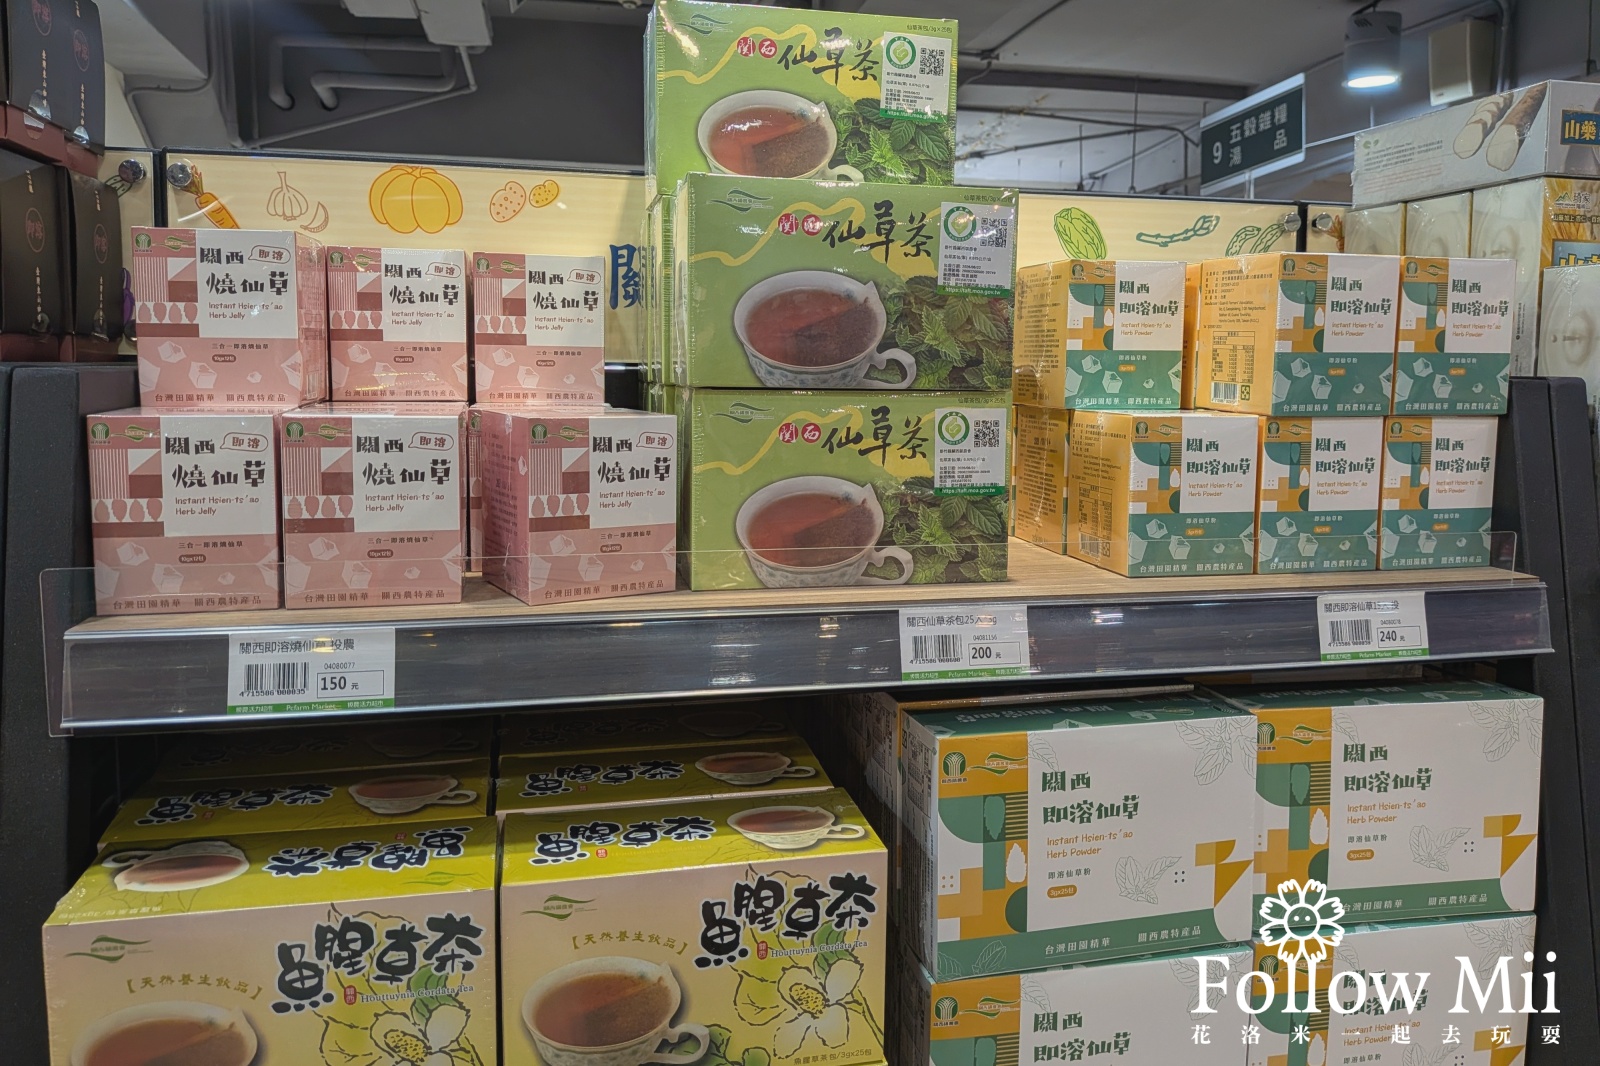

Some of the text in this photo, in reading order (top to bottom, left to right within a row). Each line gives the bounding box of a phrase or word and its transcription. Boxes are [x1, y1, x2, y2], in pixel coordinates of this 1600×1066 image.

[777, 26, 880, 85] 仙草茶
[1564, 119, 1600, 141] 山藥
[1273, 129, 1288, 150] 品
[1212, 142, 1223, 164] 9
[822, 200, 934, 263] 仙草茶
[200, 247, 284, 266] 關西 即溶
[384, 263, 422, 279] 關西
[528, 269, 564, 285] 關西
[205, 270, 288, 297] 燒仙草
[1119, 280, 1150, 294] 關西
[1331, 276, 1363, 291] 關西
[1451, 279, 1482, 294] 關西
[388, 283, 461, 306] 燒仙草
[532, 290, 599, 311] 燒仙草
[208, 302, 236, 311] Instant
[390, 309, 415, 318] Instant
[1119, 300, 1180, 316] 即溶仙草
[1330, 298, 1392, 316] 即溶仙草
[1451, 300, 1510, 317] 即溶仙草
[208, 311, 246, 321] Herb Jelly
[390, 318, 423, 327] Herb Jelly
[534, 315, 557, 323] Instant
[534, 323, 564, 332] Herb Jelly
[822, 405, 929, 467] 仙草茶
[165, 436, 262, 455] 關西 即溶
[356, 435, 446, 454] 關西 即溶
[593, 435, 668, 454] 關西 即溶
[1186, 438, 1219, 453] 關西
[1315, 437, 1346, 453] 關西
[1435, 437, 1464, 452] 關西
[362, 458, 452, 487] 燒仙草
[597, 457, 671, 484] 燒仙草
[1186, 457, 1251, 476] 即溶仙草
[1315, 456, 1376, 475] 即溶仙草
[1435, 456, 1491, 474] 即溶仙草
[171, 460, 266, 489] 燒仙草
[175, 495, 206, 505] Instant
[365, 493, 395, 502] Instant
[599, 490, 624, 499] Instant
[1188, 490, 1224, 498] Herb Powder
[175, 506, 217, 518] Herb Jelly
[365, 503, 404, 514] Herb Jelly
[599, 500, 632, 511] Herb Jelly
[1379, 630, 1397, 642] 240
[971, 646, 992, 659] 200
[320, 676, 359, 690] 150 元
[1342, 742, 1389, 763] 關西
[1041, 769, 1092, 793] 關西
[1343, 767, 1433, 794] 即溶仙草
[1042, 794, 1140, 825] 即溶仙草
[1346, 801, 1377, 813] Instant
[1346, 813, 1397, 825] Herb Powder
[528, 815, 716, 866] 魚腥草茶
[1046, 834, 1079, 848] Instant
[1347, 833, 1388, 844] 即溶仙草粉
[1046, 846, 1103, 860] Herb Powder
[1047, 867, 1092, 880] 即溶仙草粉
[1342, 898, 1403, 913] 台灣田園精華
[1427, 893, 1488, 906] 關西農特產品
[693, 871, 878, 969] 魚腥草茶
[1137, 924, 1202, 944] 關西農特產品
[771, 940, 868, 958] Houttuynia Cordata Tea
[1044, 936, 1111, 956] 台灣田園精華
[271, 912, 484, 1014] 魚腥草茶
[360, 984, 474, 1004] Houttuynia Cordata Tea
[1033, 1010, 1084, 1034] 關西
[1033, 1031, 1132, 1063] 即溶仙草
[1343, 1034, 1393, 1047] Herb Powder
